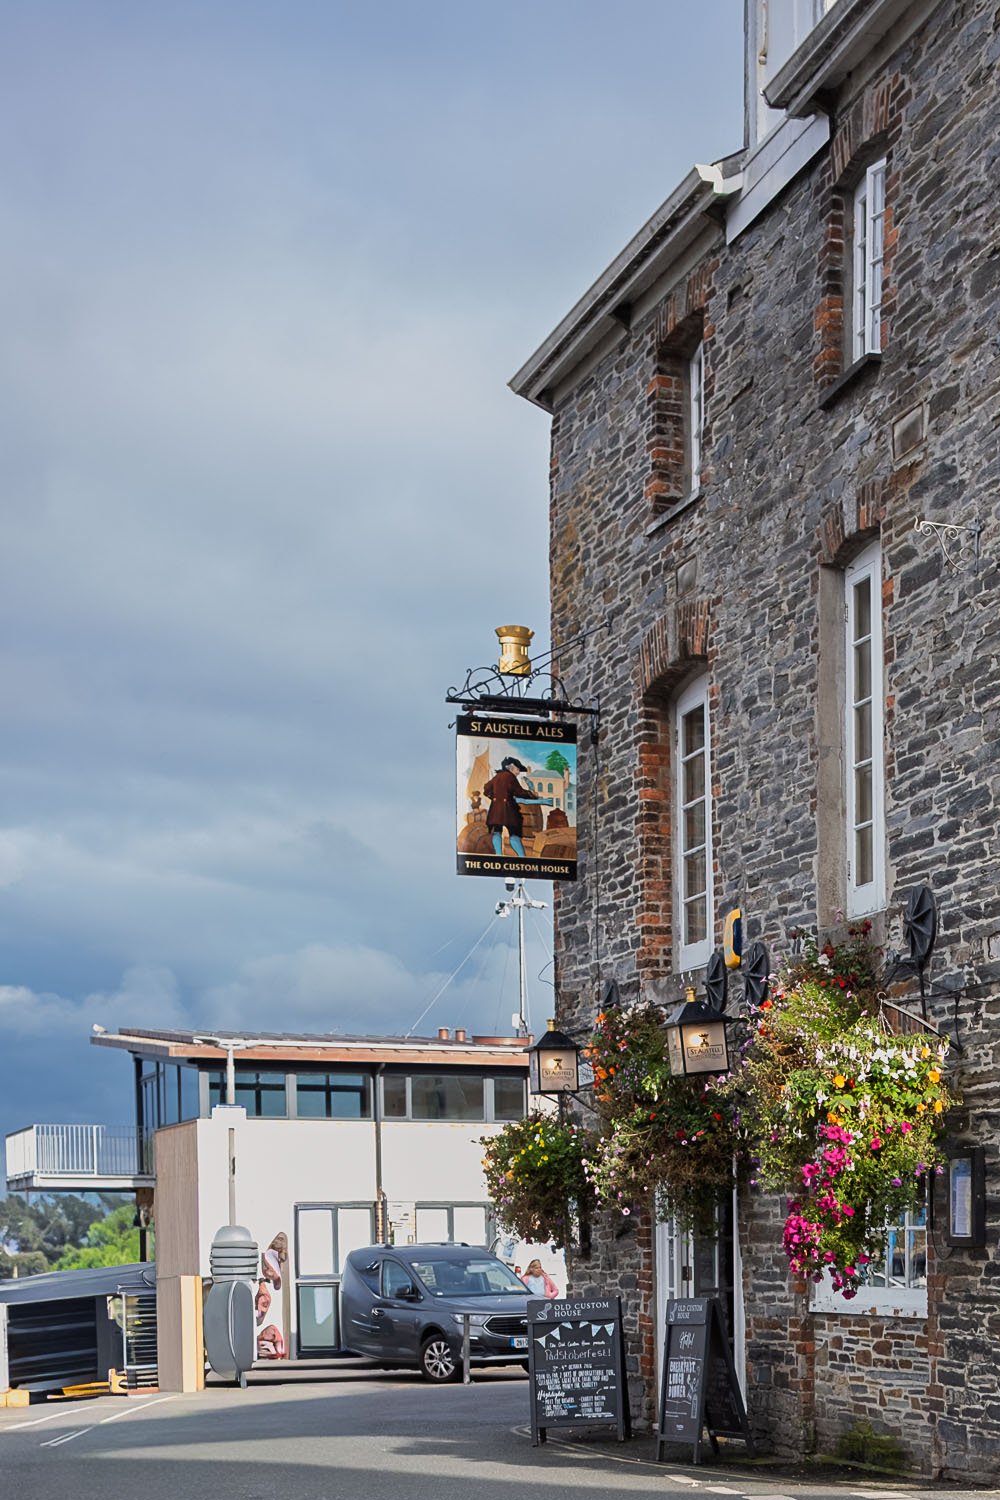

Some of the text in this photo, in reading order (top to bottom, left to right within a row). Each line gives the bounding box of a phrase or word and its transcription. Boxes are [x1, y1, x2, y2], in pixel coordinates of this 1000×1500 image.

[484, 723, 532, 735] AUSTELL
[536, 727, 564, 738] ALES
[465, 861, 569, 874] THE OLD CUSTOM HOUSE
[574, 1302, 609, 1310] CUSTOM
[554, 1310, 582, 1318] HOUSE
